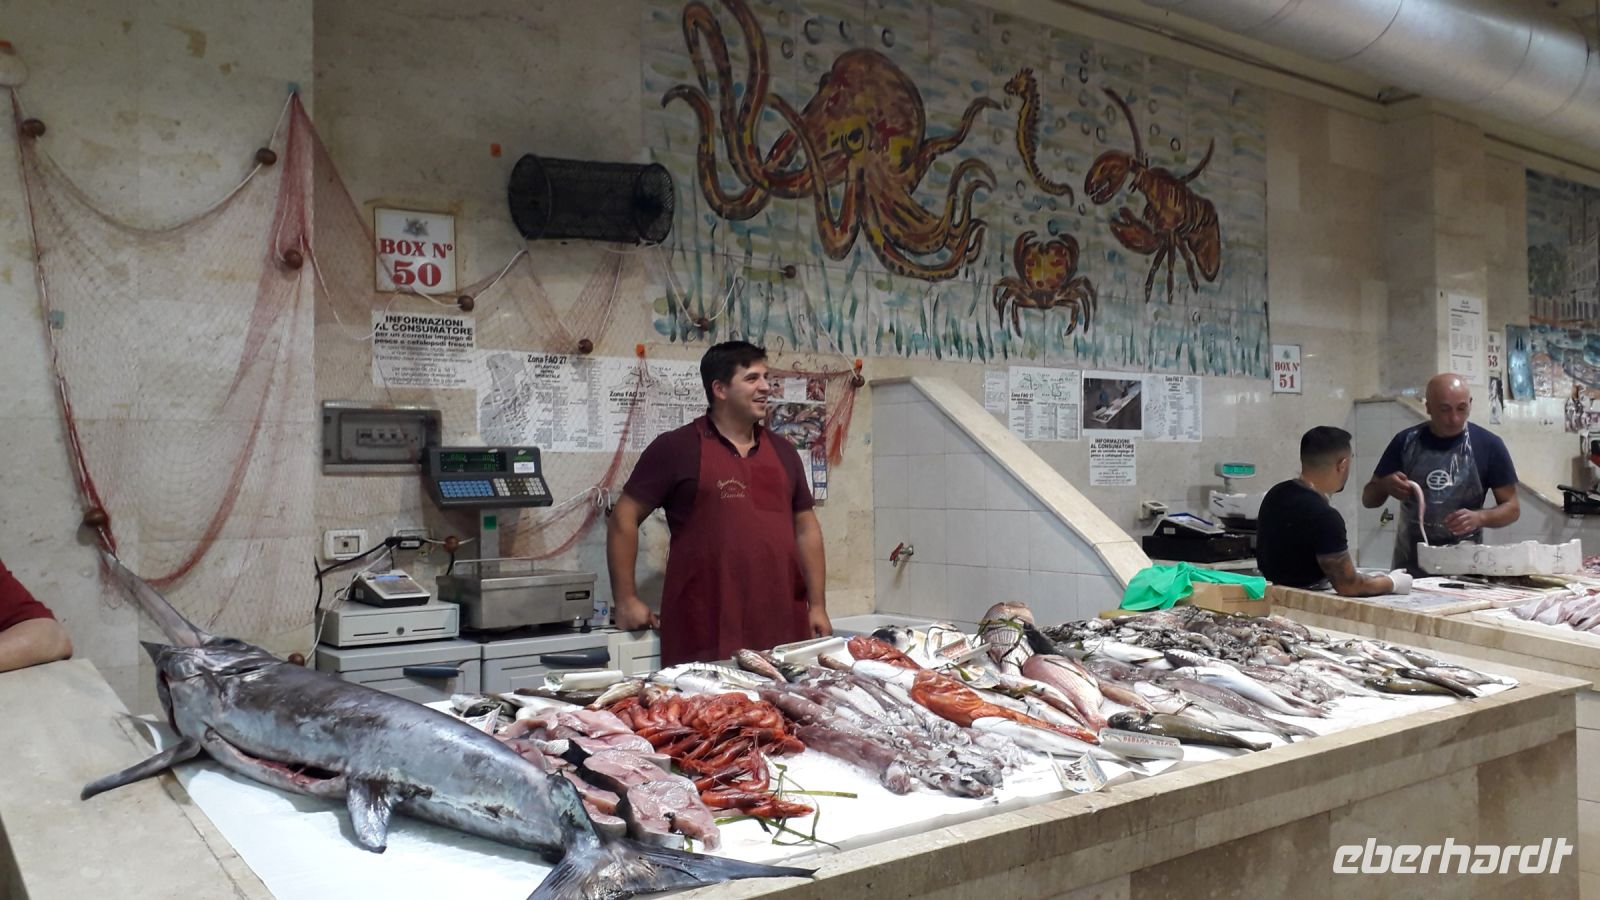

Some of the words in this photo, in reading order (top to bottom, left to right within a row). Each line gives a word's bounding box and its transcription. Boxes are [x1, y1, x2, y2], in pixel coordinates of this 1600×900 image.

[379, 237, 426, 257] BOX
[392, 260, 442, 288] 50
[385, 315, 463, 327] INFORMAZIONI
[374, 322, 389, 331] AL
[391, 323, 473, 336] CONSUMATORE
[402, 332, 433, 340] corretto
[434, 333, 464, 341] impiego
[407, 339, 447, 348] cefalopodi
[527, 354, 543, 363] Zona
[544, 355, 558, 364] FAO
[559, 356, 567, 365] 27
[1274, 361, 1291, 371] BOX
[1279, 374, 1295, 389] 51
